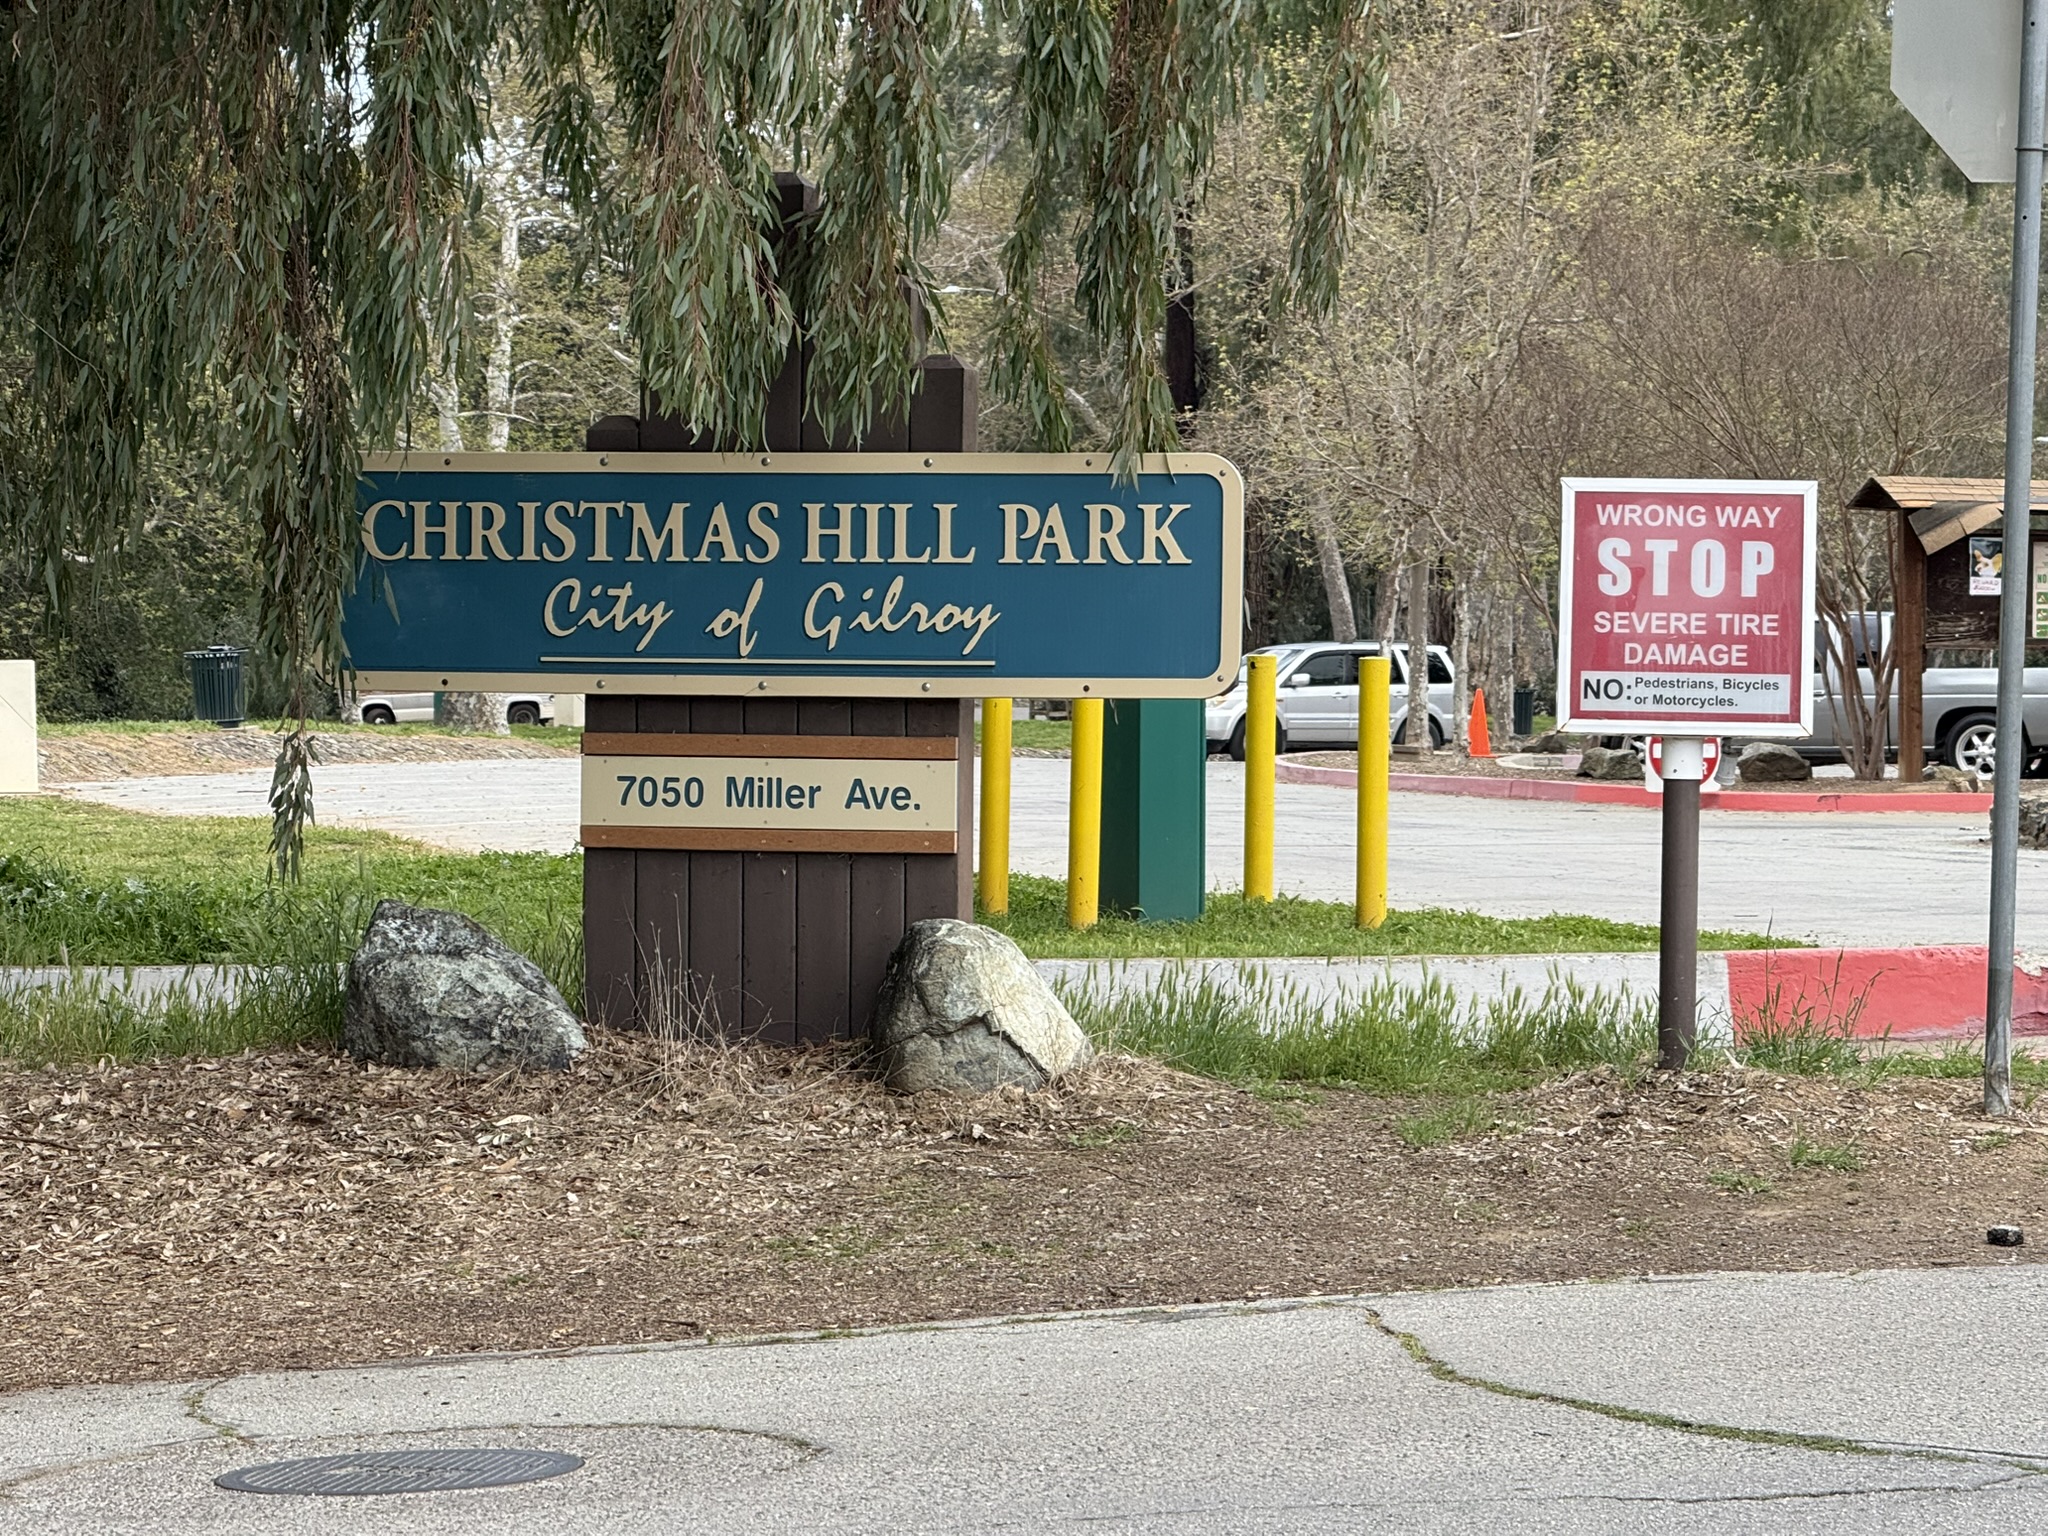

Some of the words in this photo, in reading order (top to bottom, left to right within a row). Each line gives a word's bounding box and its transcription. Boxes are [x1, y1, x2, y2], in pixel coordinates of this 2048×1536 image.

[1596, 504, 1707, 527] WRONG
[1715, 506, 1782, 528] WAY
[361, 500, 780, 564] CHRISTMAS
[801, 502, 976, 564] HILL
[998, 502, 1193, 565] PARK
[1597, 537, 1775, 598] STOP
[543, 577, 674, 652] City
[705, 577, 764, 657] of
[803, 575, 1001, 656] Gilroy
[1593, 611, 1707, 634] SEVERE
[1715, 613, 1779, 636] TIRE
[1624, 643, 1749, 667] DAMAGE
[1583, 678, 1632, 701] NO:
[1634, 676, 1719, 692] Pedestrians,
[1722, 678, 1780, 693] Bicycles
[1634, 695, 1650, 705] or
[1652, 694, 1739, 708] Motorcycles.
[616, 775, 705, 808] 7050
[725, 776, 822, 810] Miller
[843, 778, 922, 811] Ave.
